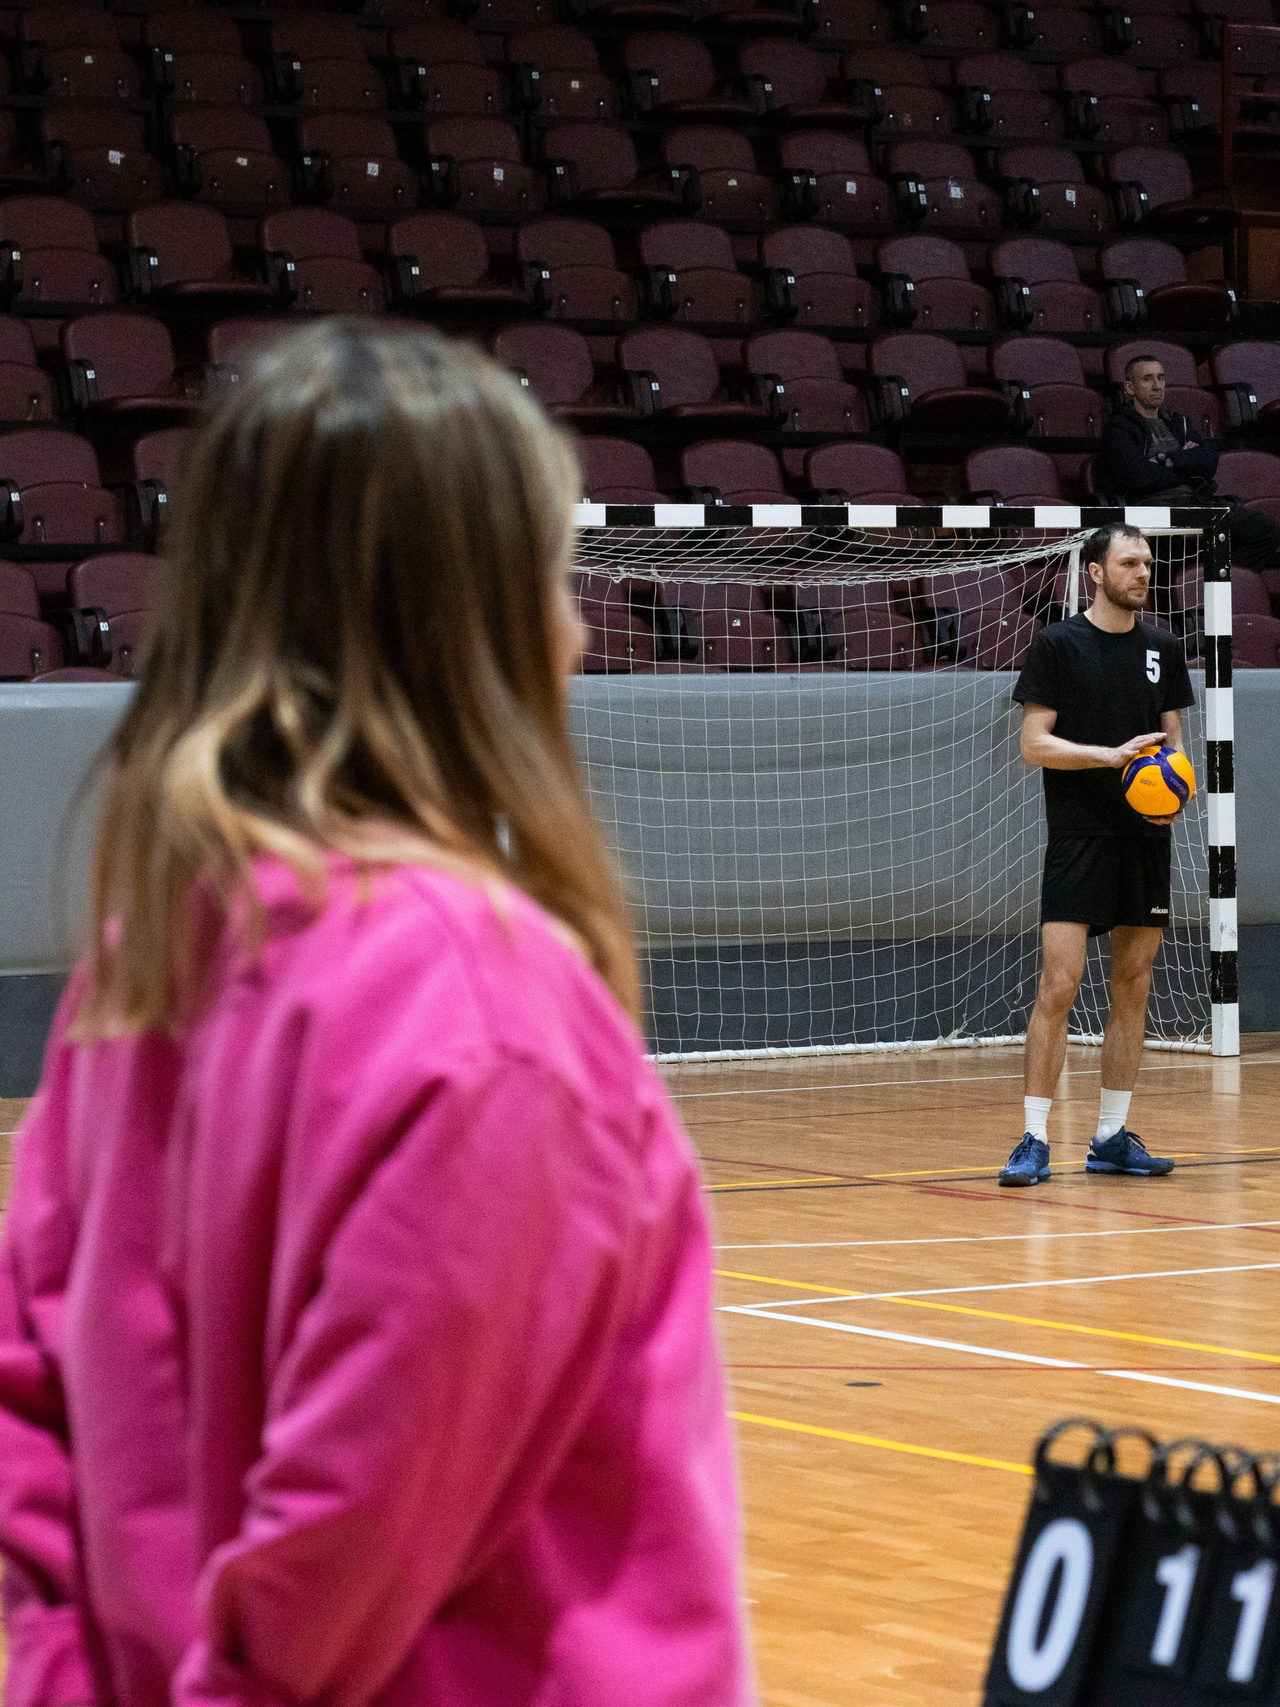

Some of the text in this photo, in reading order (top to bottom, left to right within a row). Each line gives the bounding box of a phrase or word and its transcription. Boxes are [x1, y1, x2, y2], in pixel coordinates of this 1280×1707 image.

[1146, 650, 1161, 684] 5
[1007, 1518, 1094, 1692] 0
[1151, 1544, 1200, 1666] 1
[1228, 1558, 1278, 1684] 1
